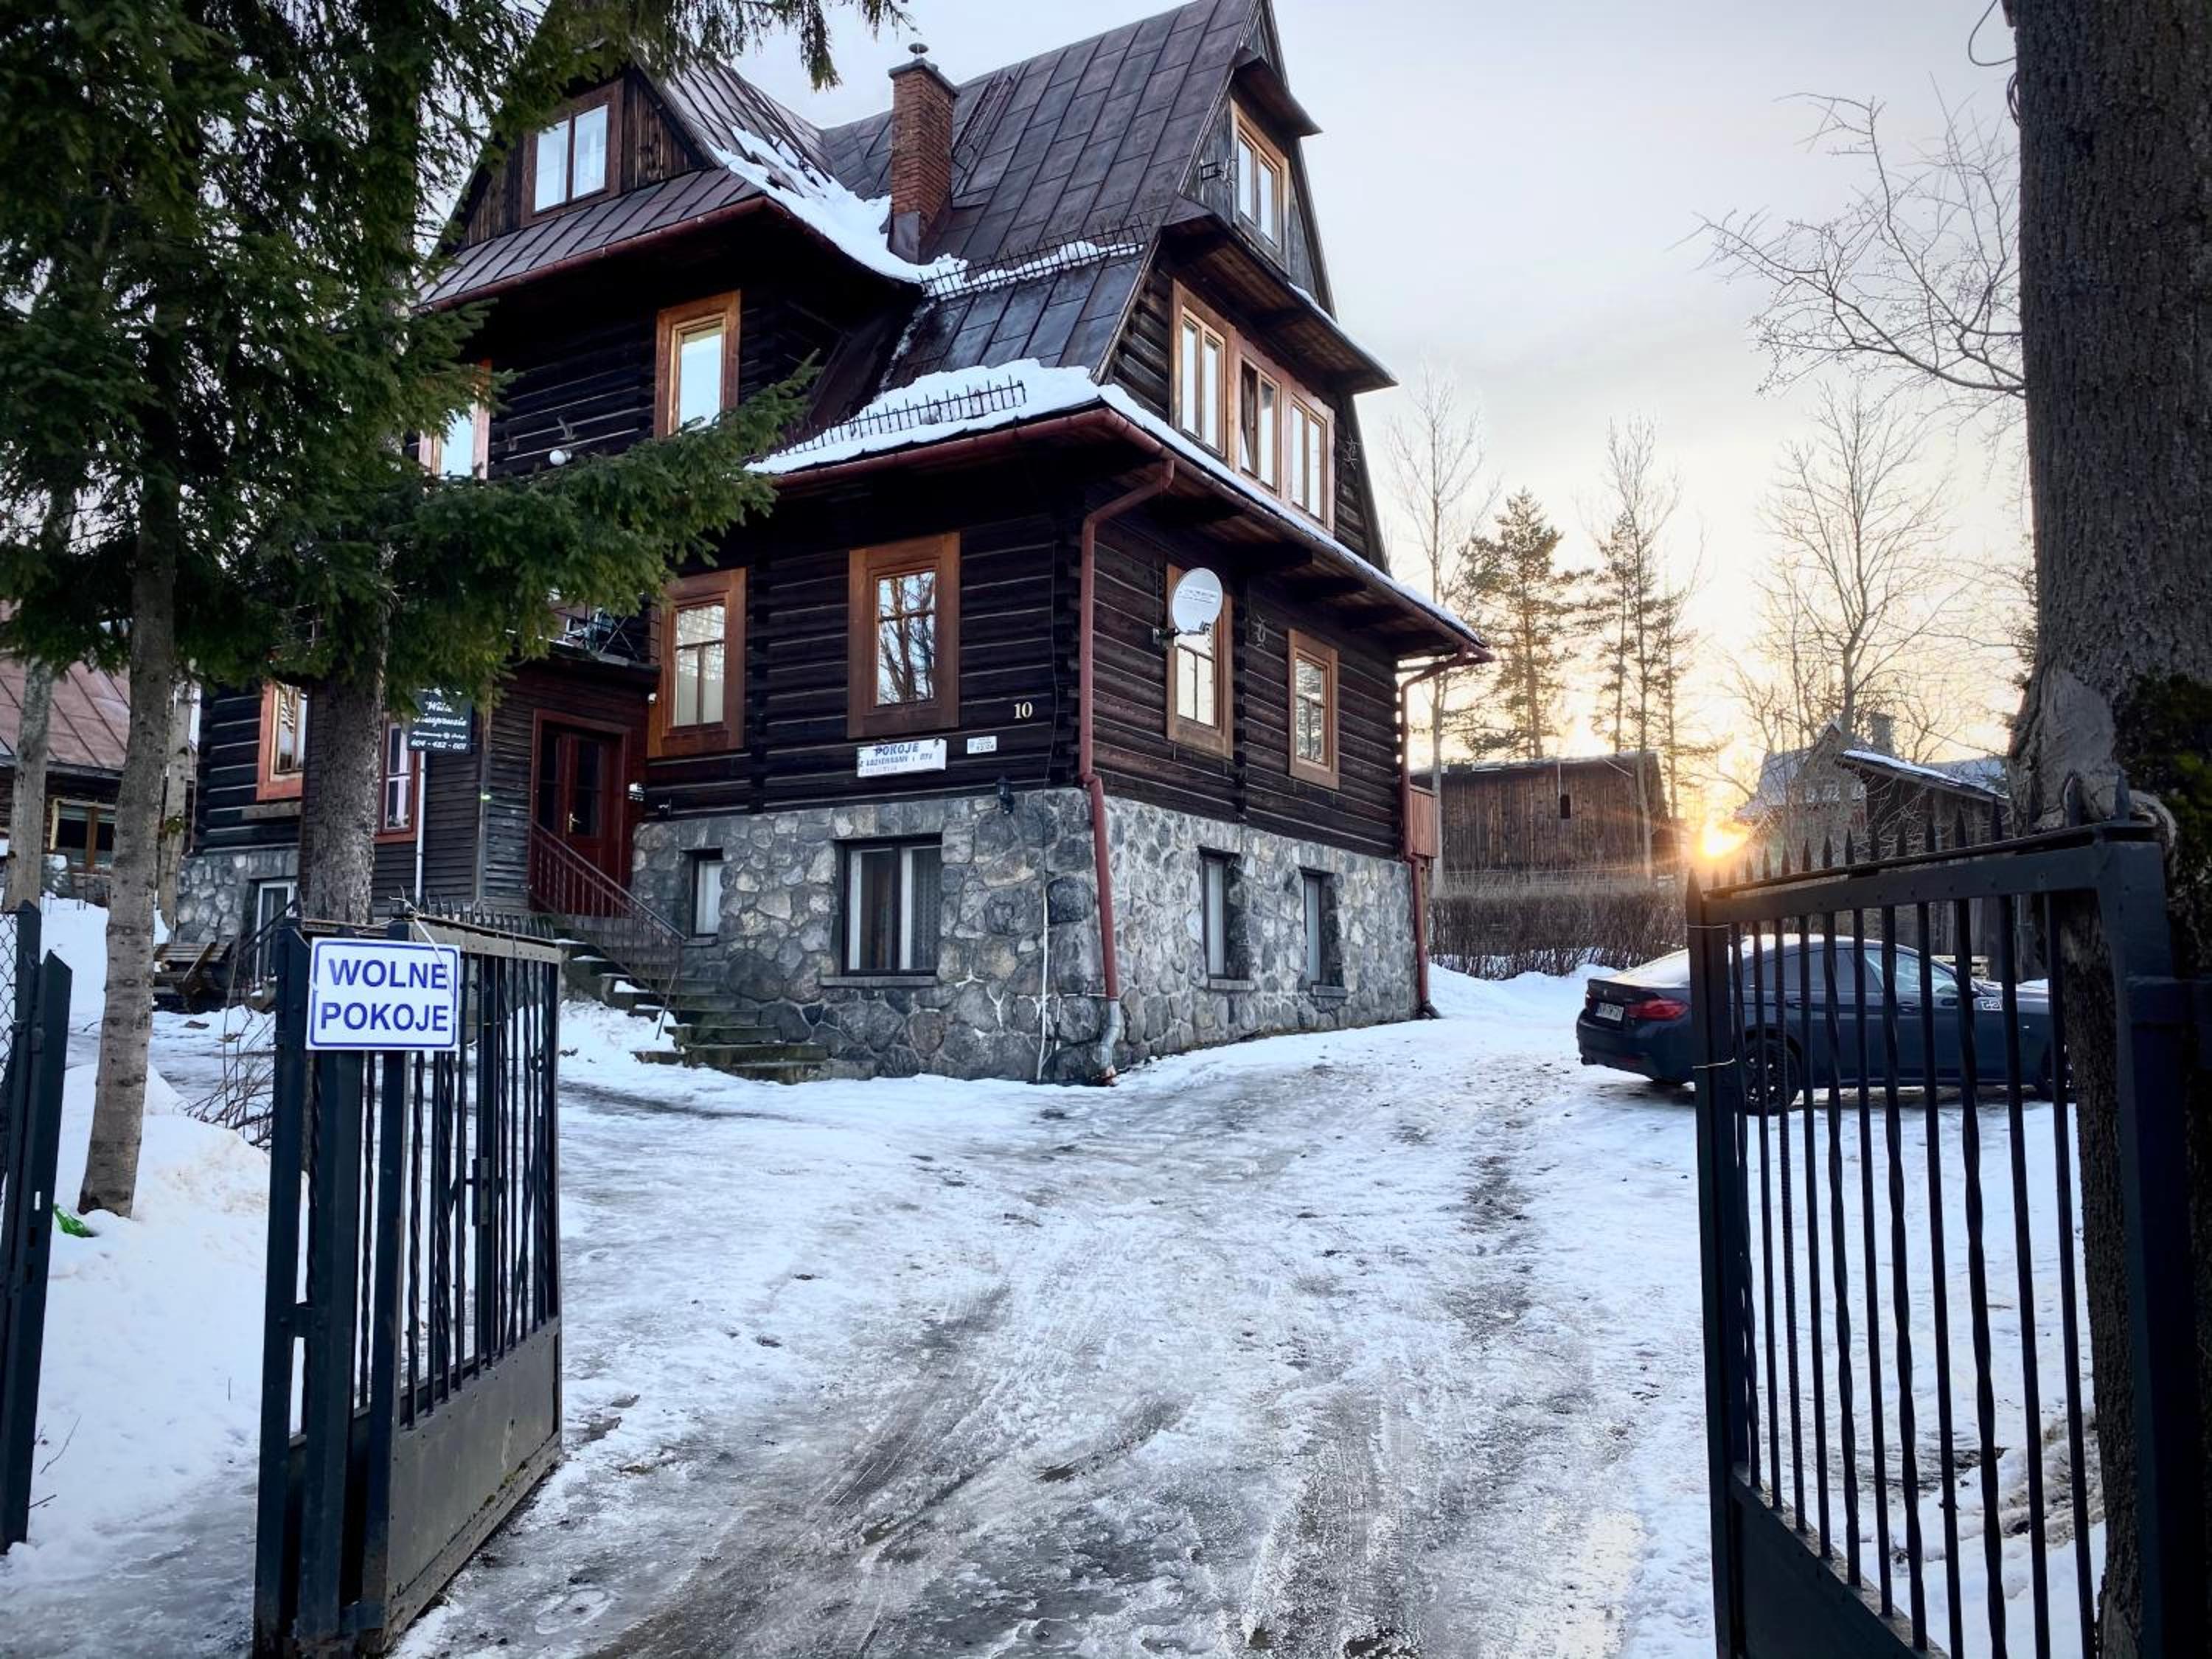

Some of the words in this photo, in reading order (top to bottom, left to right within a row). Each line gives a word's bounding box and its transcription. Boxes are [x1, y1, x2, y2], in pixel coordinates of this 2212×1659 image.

[1014, 701, 1033, 719] 10
[875, 742, 919, 757] POKOJE
[329, 959, 448, 990] WOLNE
[321, 1002, 448, 1031] POKOJE
